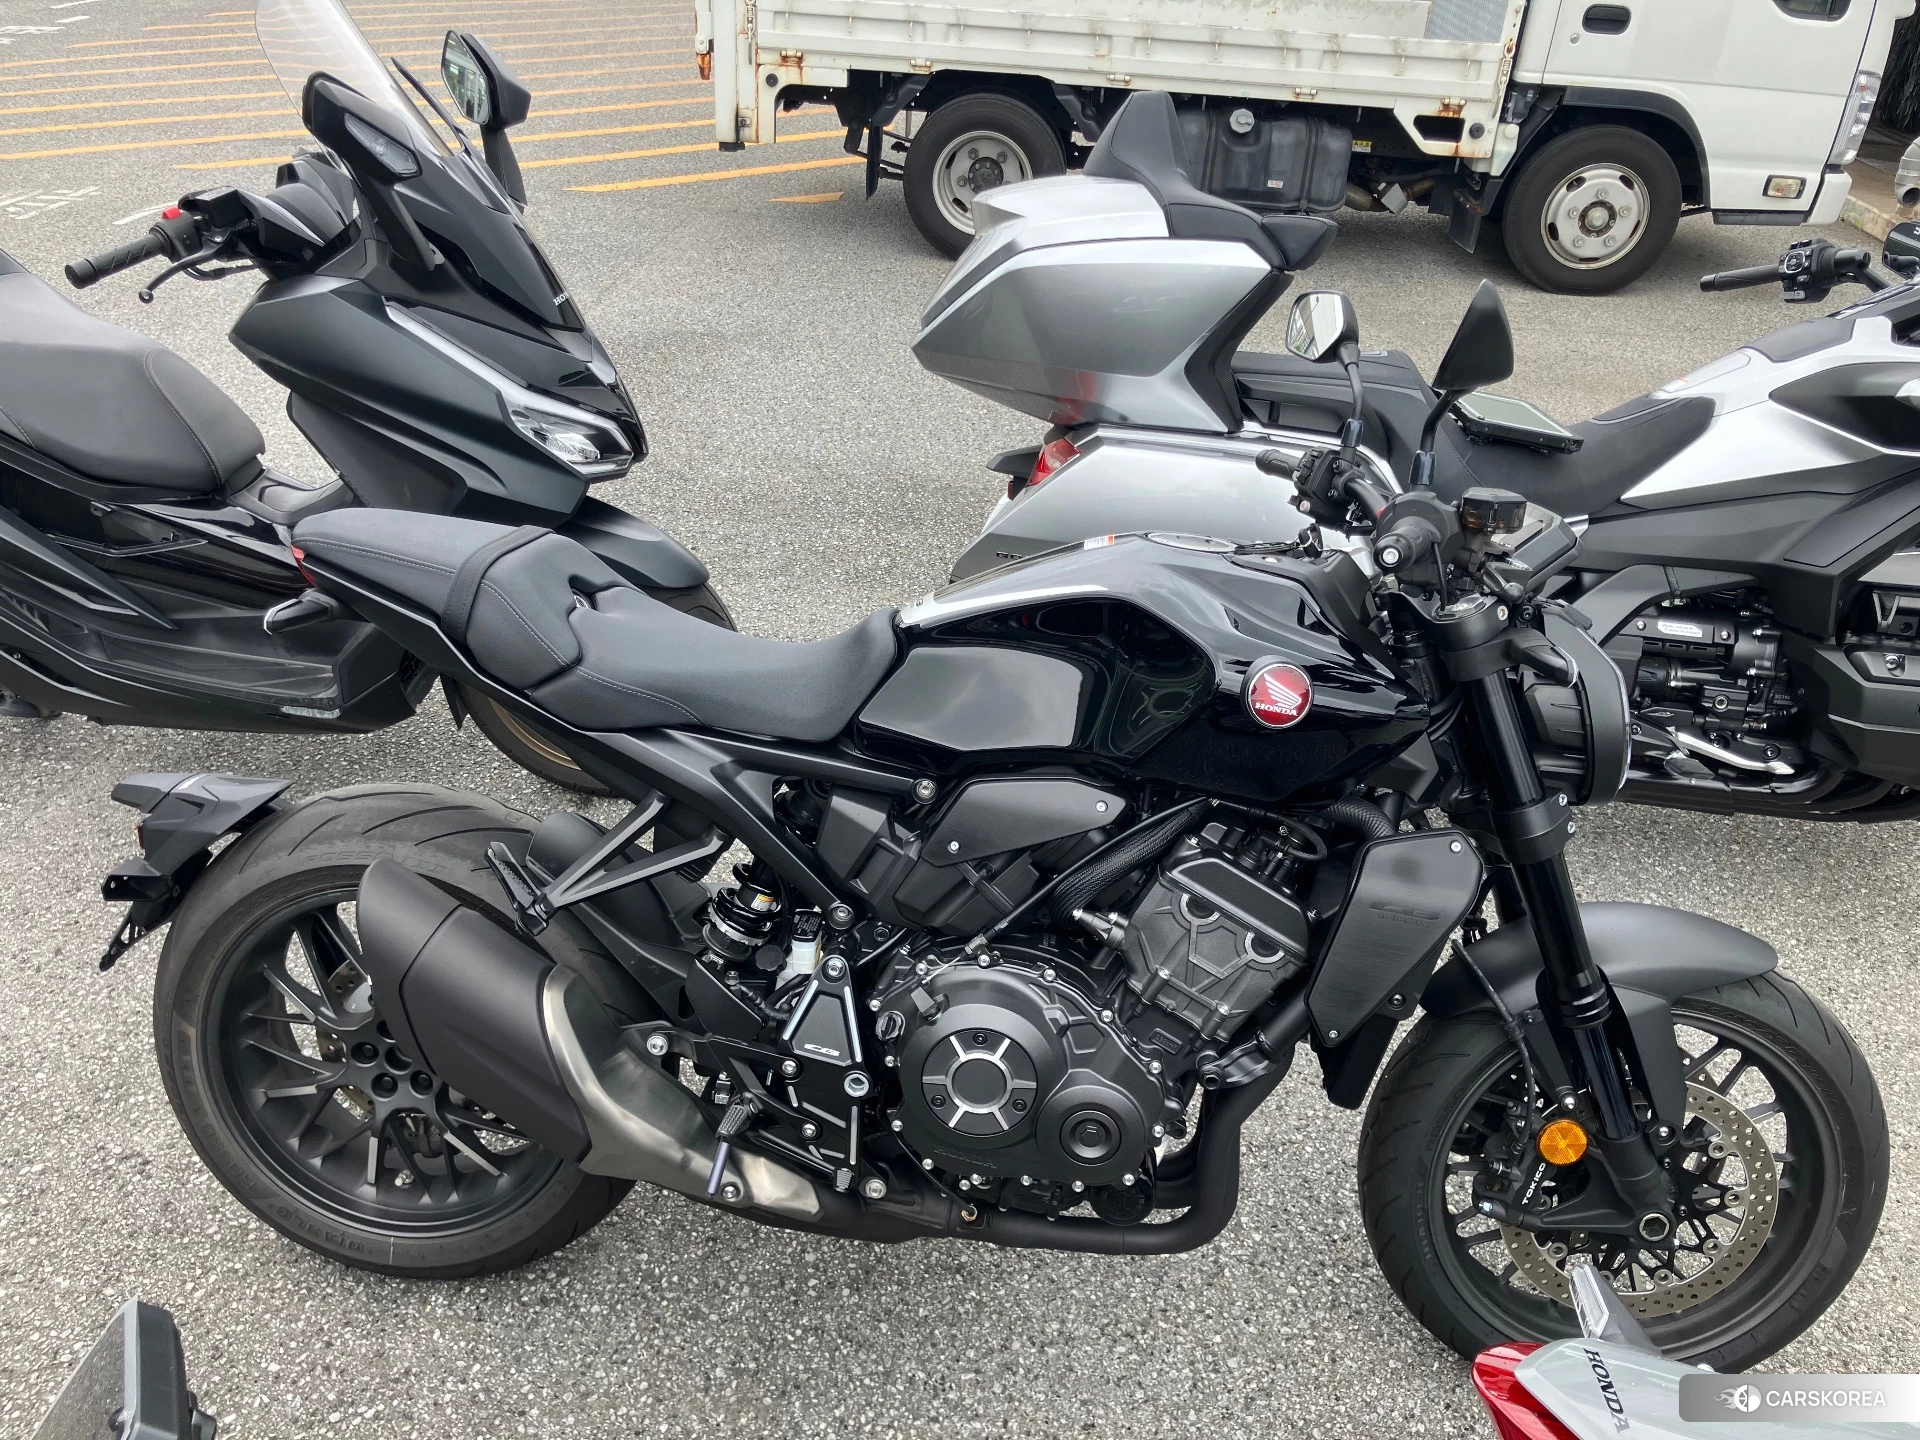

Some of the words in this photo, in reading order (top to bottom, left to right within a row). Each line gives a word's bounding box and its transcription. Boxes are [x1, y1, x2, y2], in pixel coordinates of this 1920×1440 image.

[1254, 702, 1299, 717] HONDA
[1521, 1162, 1546, 1205] TOKICO
[1583, 1347, 1631, 1434] HONDA
